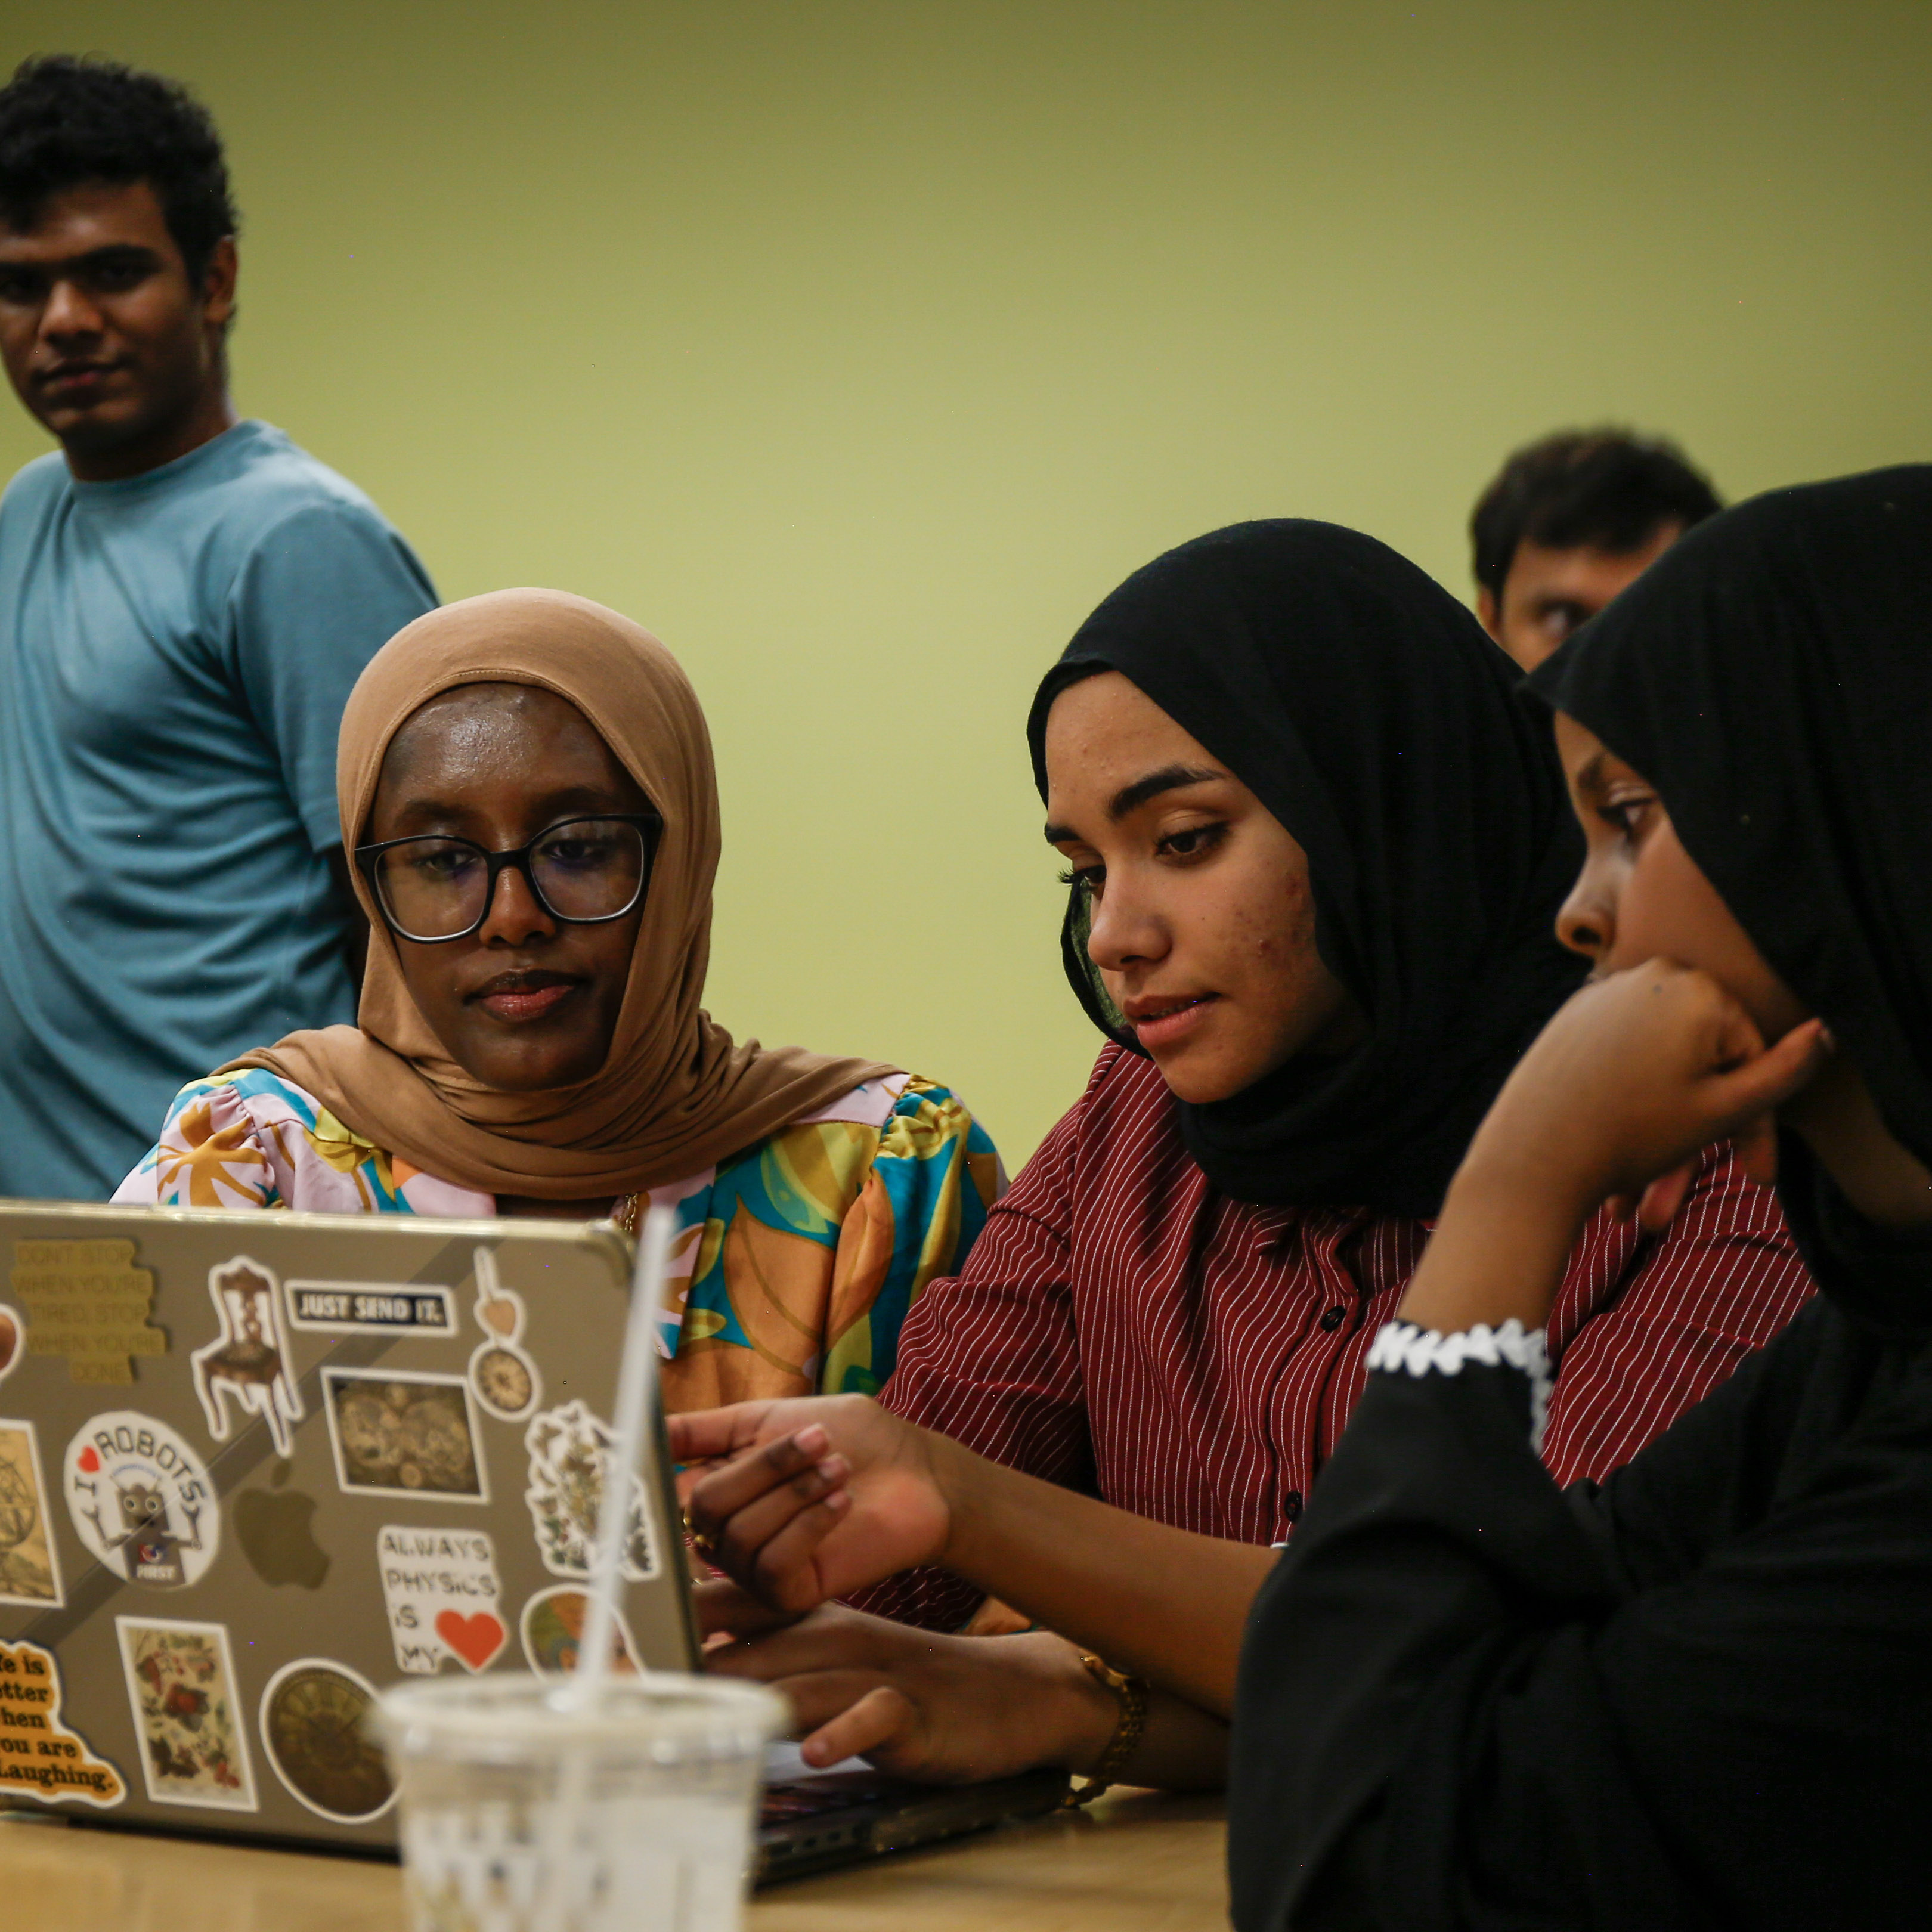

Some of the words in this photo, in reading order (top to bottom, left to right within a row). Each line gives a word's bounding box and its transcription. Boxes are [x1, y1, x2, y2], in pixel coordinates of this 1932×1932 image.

[300, 1293, 349, 1318] JUST
[355, 1295, 412, 1321] SEND
[75, 1476, 97, 1497] I
[94, 1426, 206, 1502] ROBOTS
[384, 1534, 489, 1561] ALWAYS
[137, 1565, 177, 1579] FIRST
[23, 1654, 45, 1676] is
[400, 1645, 438, 1668] MY
[0, 1682, 48, 1702] tter
[38, 1741, 77, 1758] are
